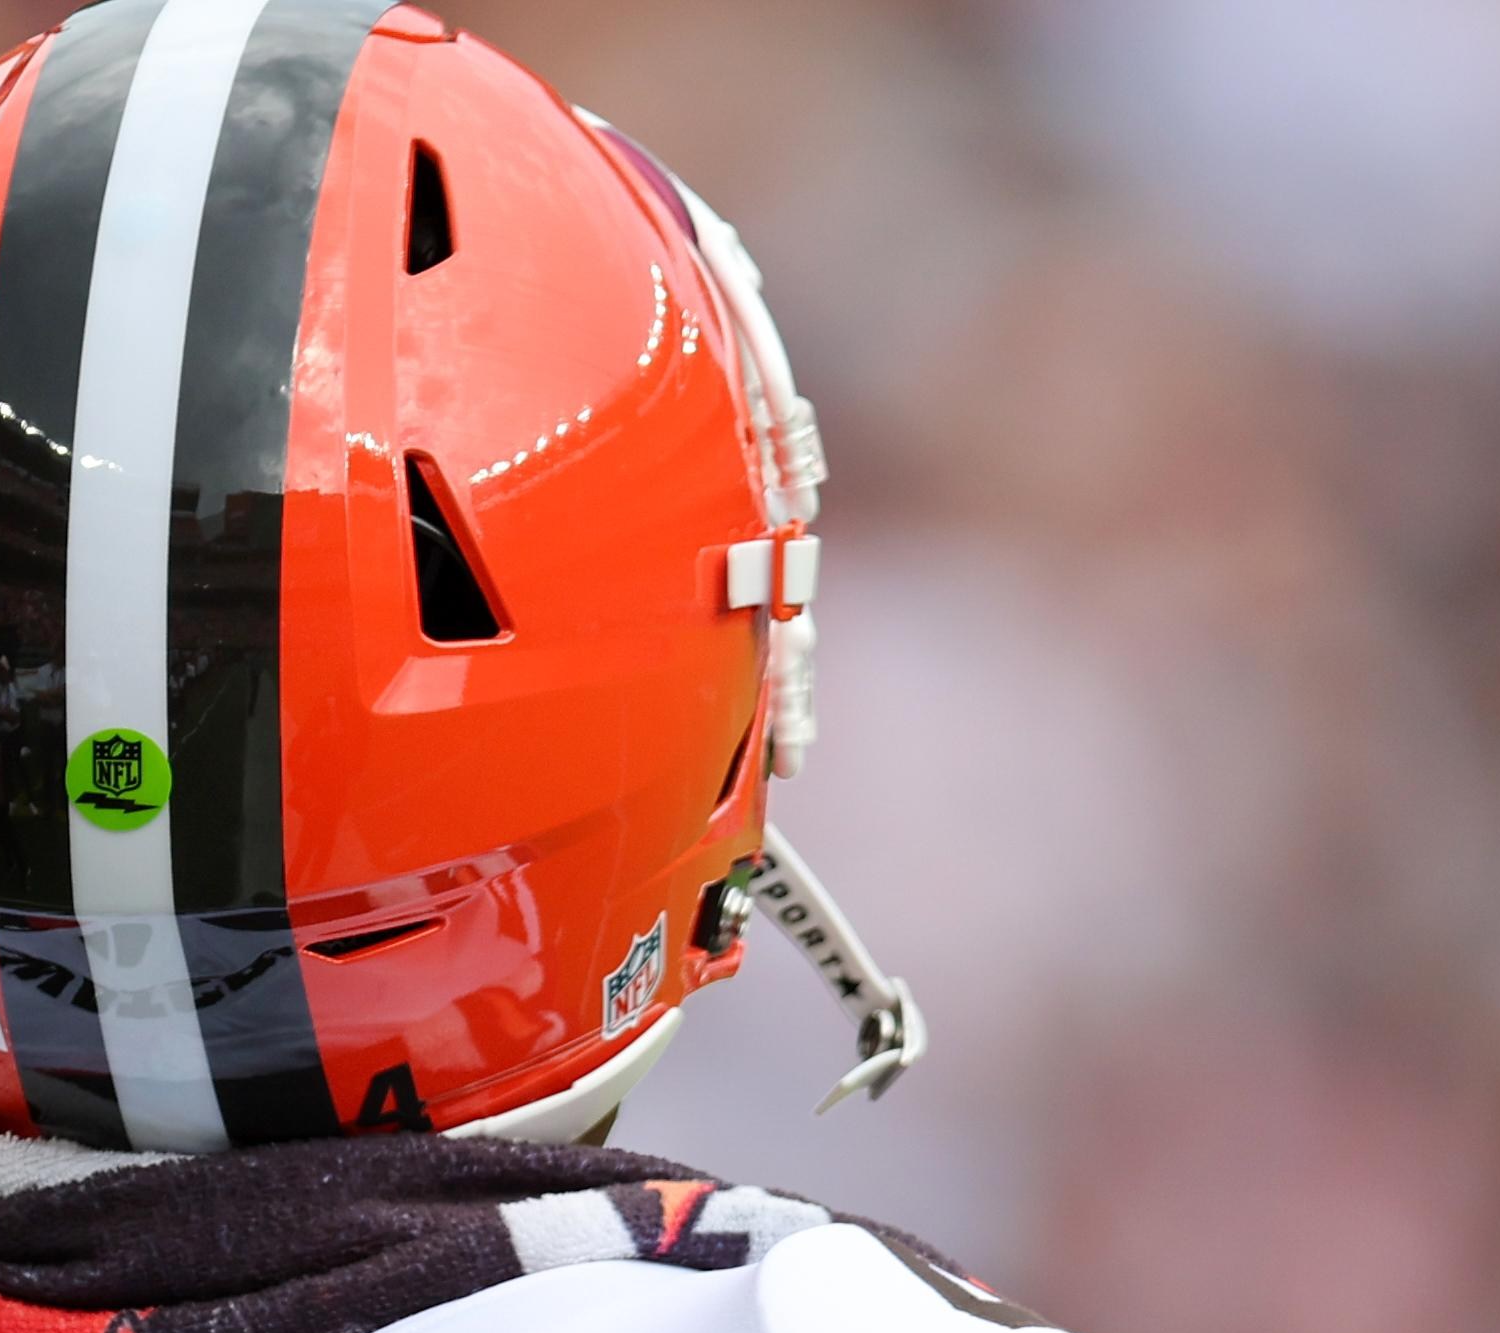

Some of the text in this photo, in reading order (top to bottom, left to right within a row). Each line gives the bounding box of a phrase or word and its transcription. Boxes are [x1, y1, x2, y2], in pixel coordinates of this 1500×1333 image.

[96, 760, 138, 790] NFL
[613, 957, 658, 1019] NFL
[358, 1061, 433, 1132] 4
